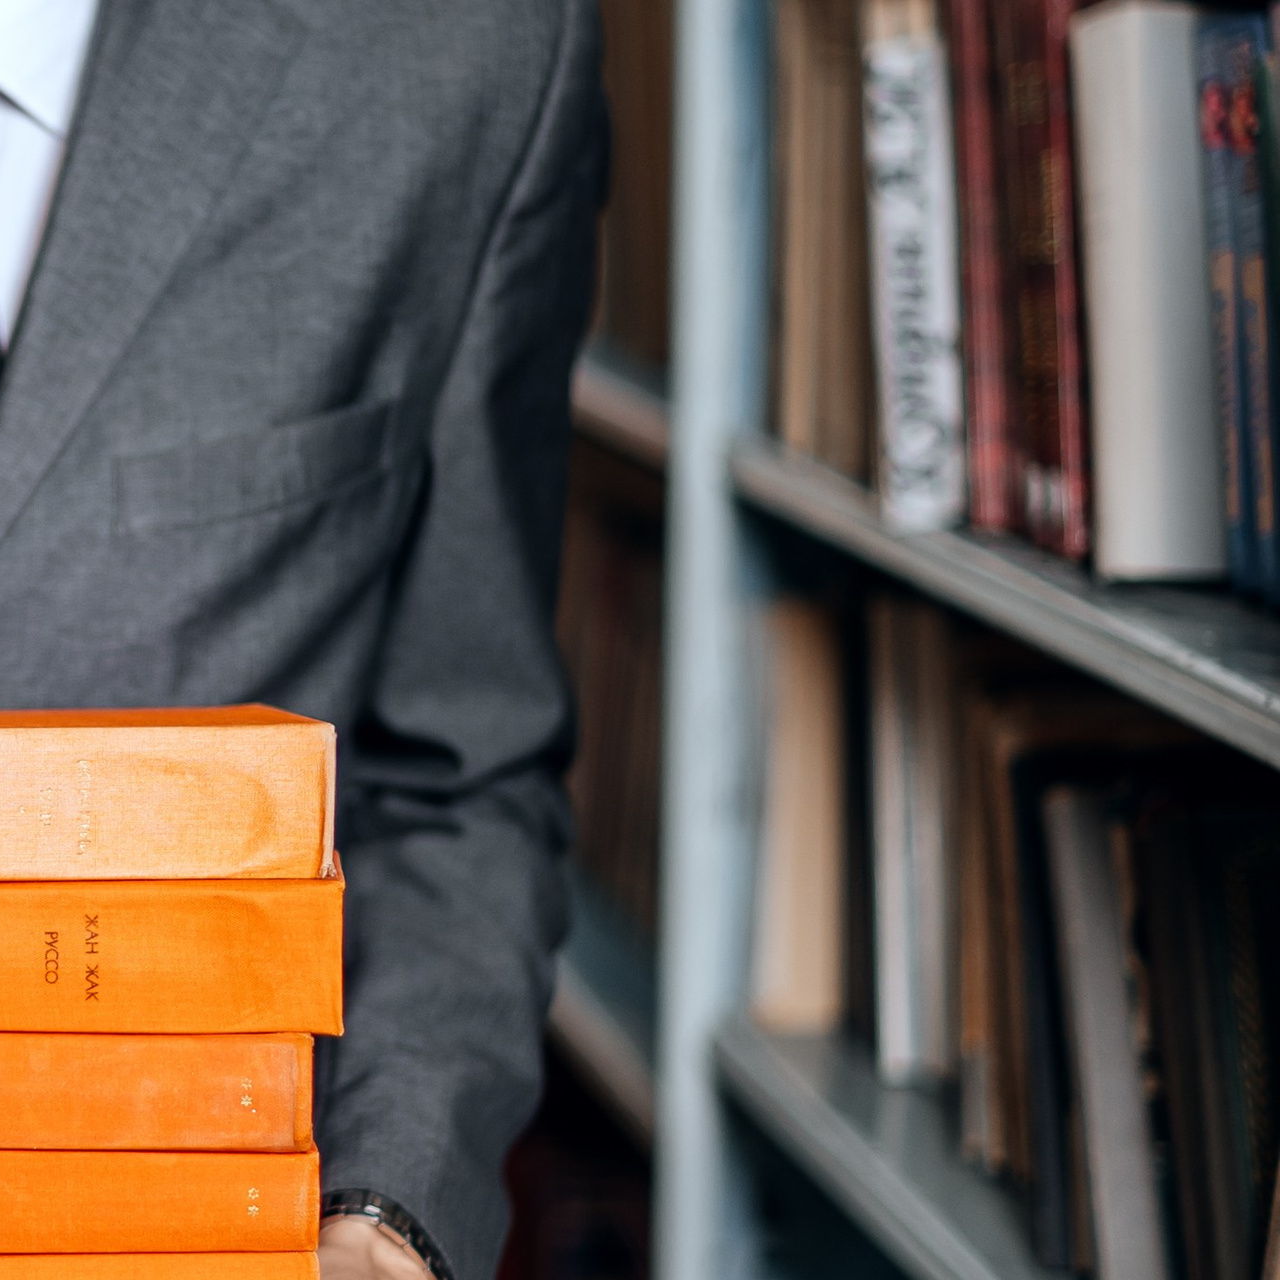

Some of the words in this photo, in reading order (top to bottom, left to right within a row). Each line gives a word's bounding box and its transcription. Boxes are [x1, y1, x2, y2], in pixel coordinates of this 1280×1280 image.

[85, 913, 100, 955] ЖАН
[44, 931, 59, 985] РУССО
[85, 964, 100, 1002] ЖАК
